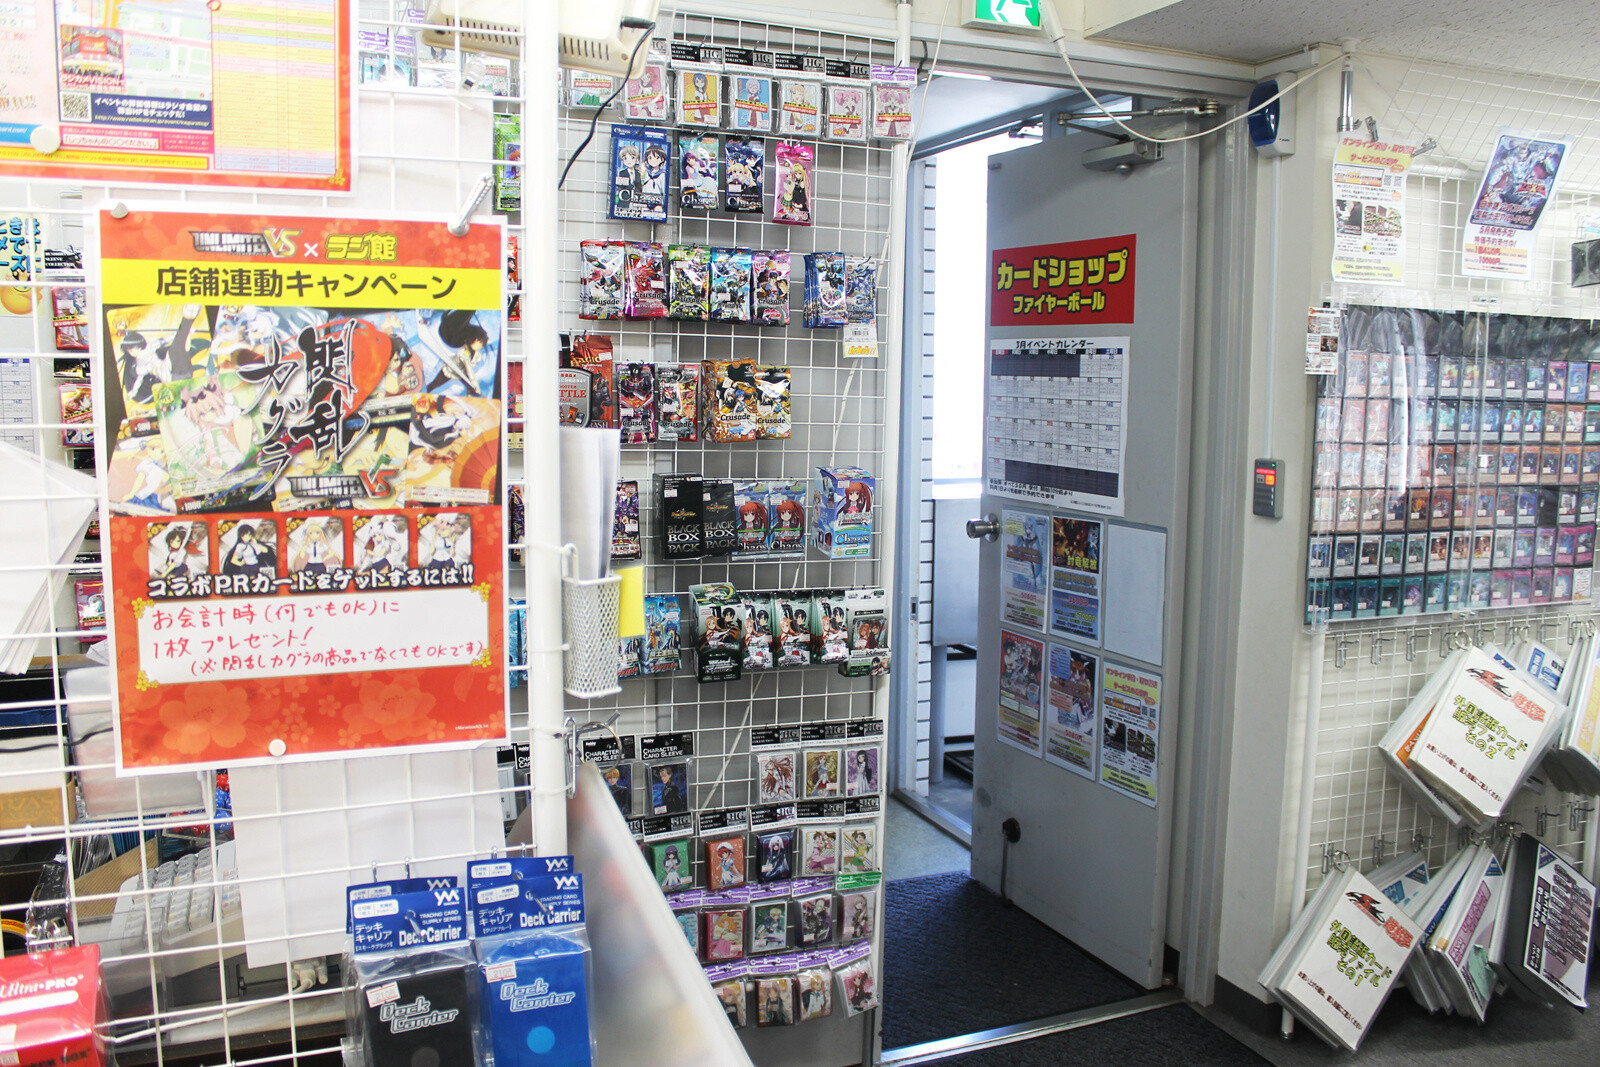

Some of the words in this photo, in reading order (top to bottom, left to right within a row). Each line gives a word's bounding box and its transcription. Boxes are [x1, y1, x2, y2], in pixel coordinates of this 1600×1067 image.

[703, 50, 719, 59] HG
[755, 54, 770, 63] HG
[806, 58, 821, 67] HG
[854, 65, 867, 75] HG
[997, 246, 1129, 291] カードショップ
[156, 267, 457, 300] 店舗連動キャンペーン
[1012, 289, 1106, 314] ファイヤーボール
[1015, 339, 1094, 349] 3月イベントカレンダー
[559, 389, 587, 398] TTLE
[720, 413, 751, 422] Crusade
[667, 525, 700, 534] BLACK
[704, 521, 735, 530] BLACK
[667, 533, 700, 542] BOX
[705, 529, 735, 538] BOX
[834, 533, 870, 544] Chaos
[667, 544, 700, 553] PACK
[706, 538, 736, 549] PACK
[147, 565, 474, 599] コラボPRカードをゲットするには!!
[152, 598, 400, 630] お会計時(何でもOK)に
[1453, 695, 1529, 753] 外国語版カード
[1452, 707, 1516, 761] 販売ファイル
[642, 746, 678, 754] CHARACTER
[1465, 730, 1499, 760] その2
[584, 749, 620, 758] CHARACTER
[643, 752, 660, 760] CARD
[660, 750, 683, 758] SLEEVE
[539, 894, 562, 902] TRADING
[478, 907, 505, 918] デッキ
[519, 911, 545, 928] Deck
[547, 908, 581, 921] Carrier
[443, 915, 461, 923] SERIES
[478, 913, 514, 927] キャリア
[355, 924, 384, 934] デッキ
[355, 930, 393, 943] キャリア
[399, 929, 424, 947] Dec
[426, 925, 462, 942] Carrier
[1329, 919, 1393, 979] 外国語版カード
[1327, 933, 1380, 988] 販売ファイル
[1336, 959, 1364, 987] その1
[499, 977, 549, 1000] Deck
[509, 991, 576, 1013] Carrier
[380, 996, 431, 1022] Deck
[391, 1008, 459, 1034] Carrier
